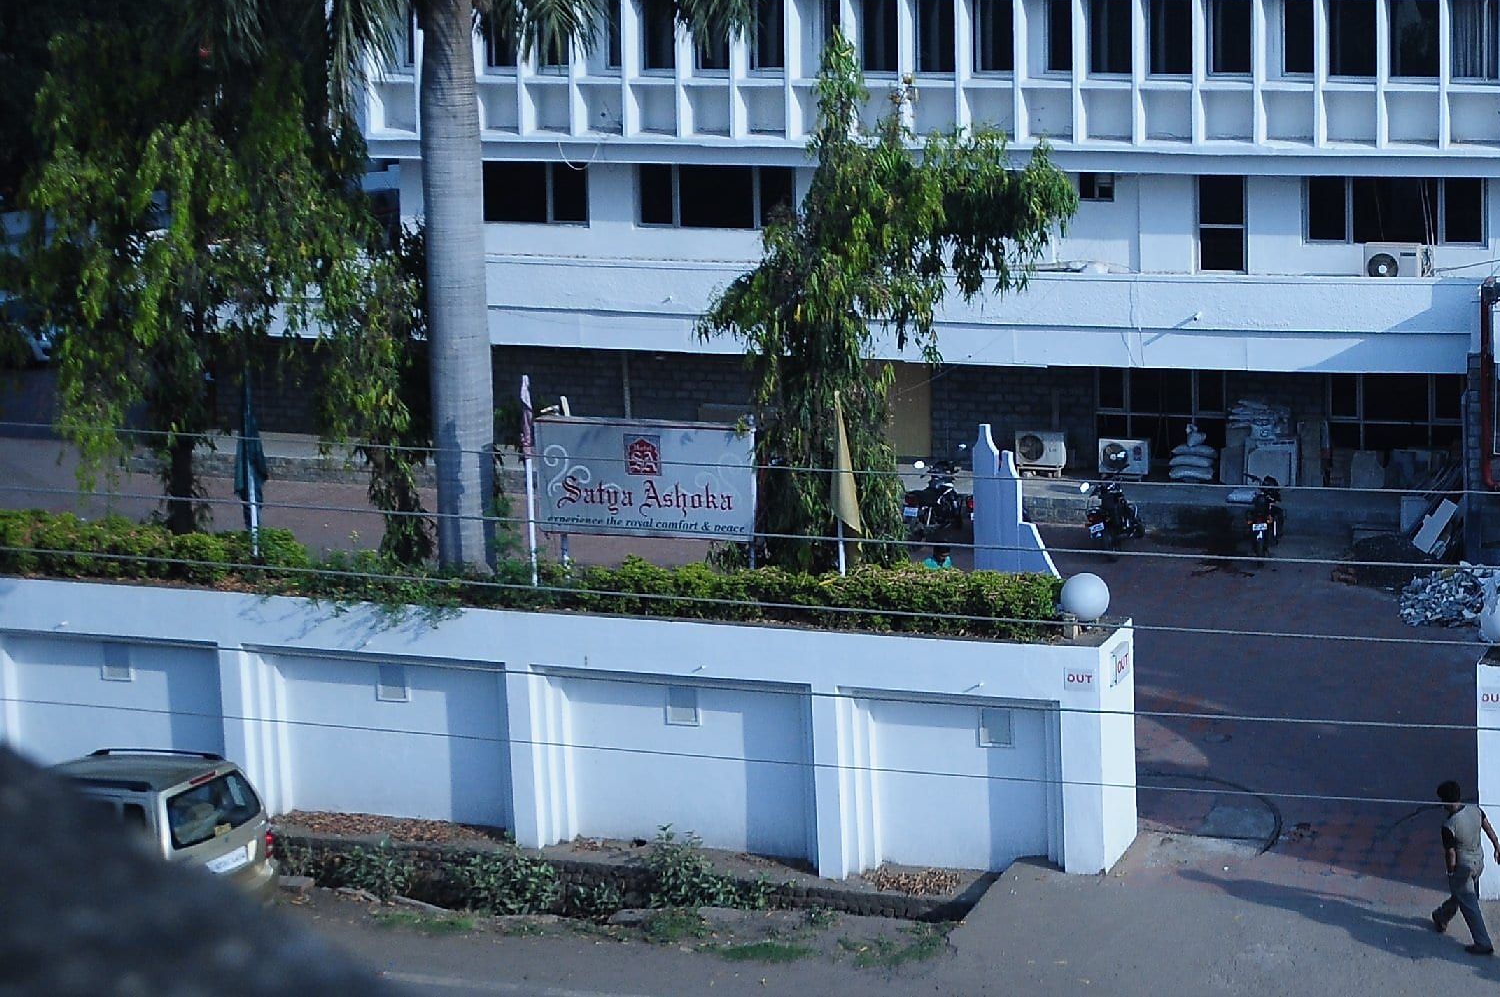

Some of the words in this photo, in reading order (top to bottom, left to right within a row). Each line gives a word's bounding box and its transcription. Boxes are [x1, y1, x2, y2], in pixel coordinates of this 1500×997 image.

[557, 475, 633, 516] Satya
[638, 479, 734, 518] Ashoka
[606, 516, 623, 526] the
[625, 517, 653, 529] royal
[655, 519, 698, 531] comfort
[700, 521, 710, 531] &
[713, 523, 745, 534] peace
[1117, 652, 1129, 674] OUT
[1067, 673, 1093, 684] OUT
